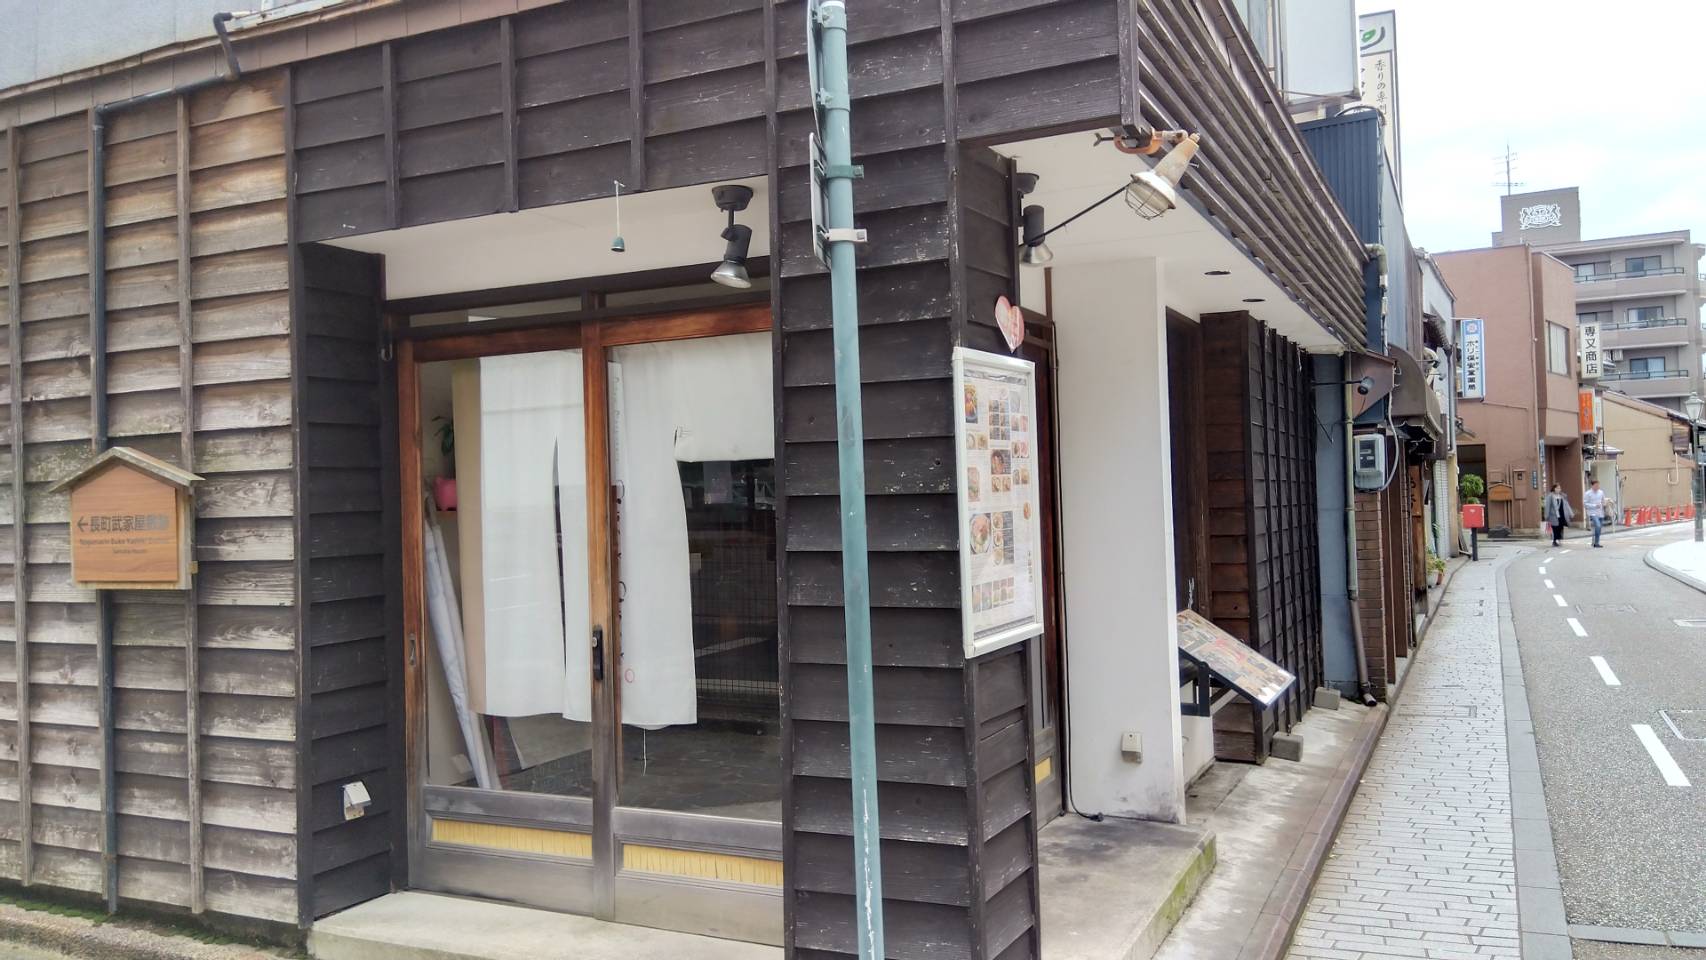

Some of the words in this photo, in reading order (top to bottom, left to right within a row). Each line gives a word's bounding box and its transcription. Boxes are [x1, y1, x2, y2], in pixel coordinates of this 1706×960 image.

[90, 514, 168, 532] 長町武家屋
